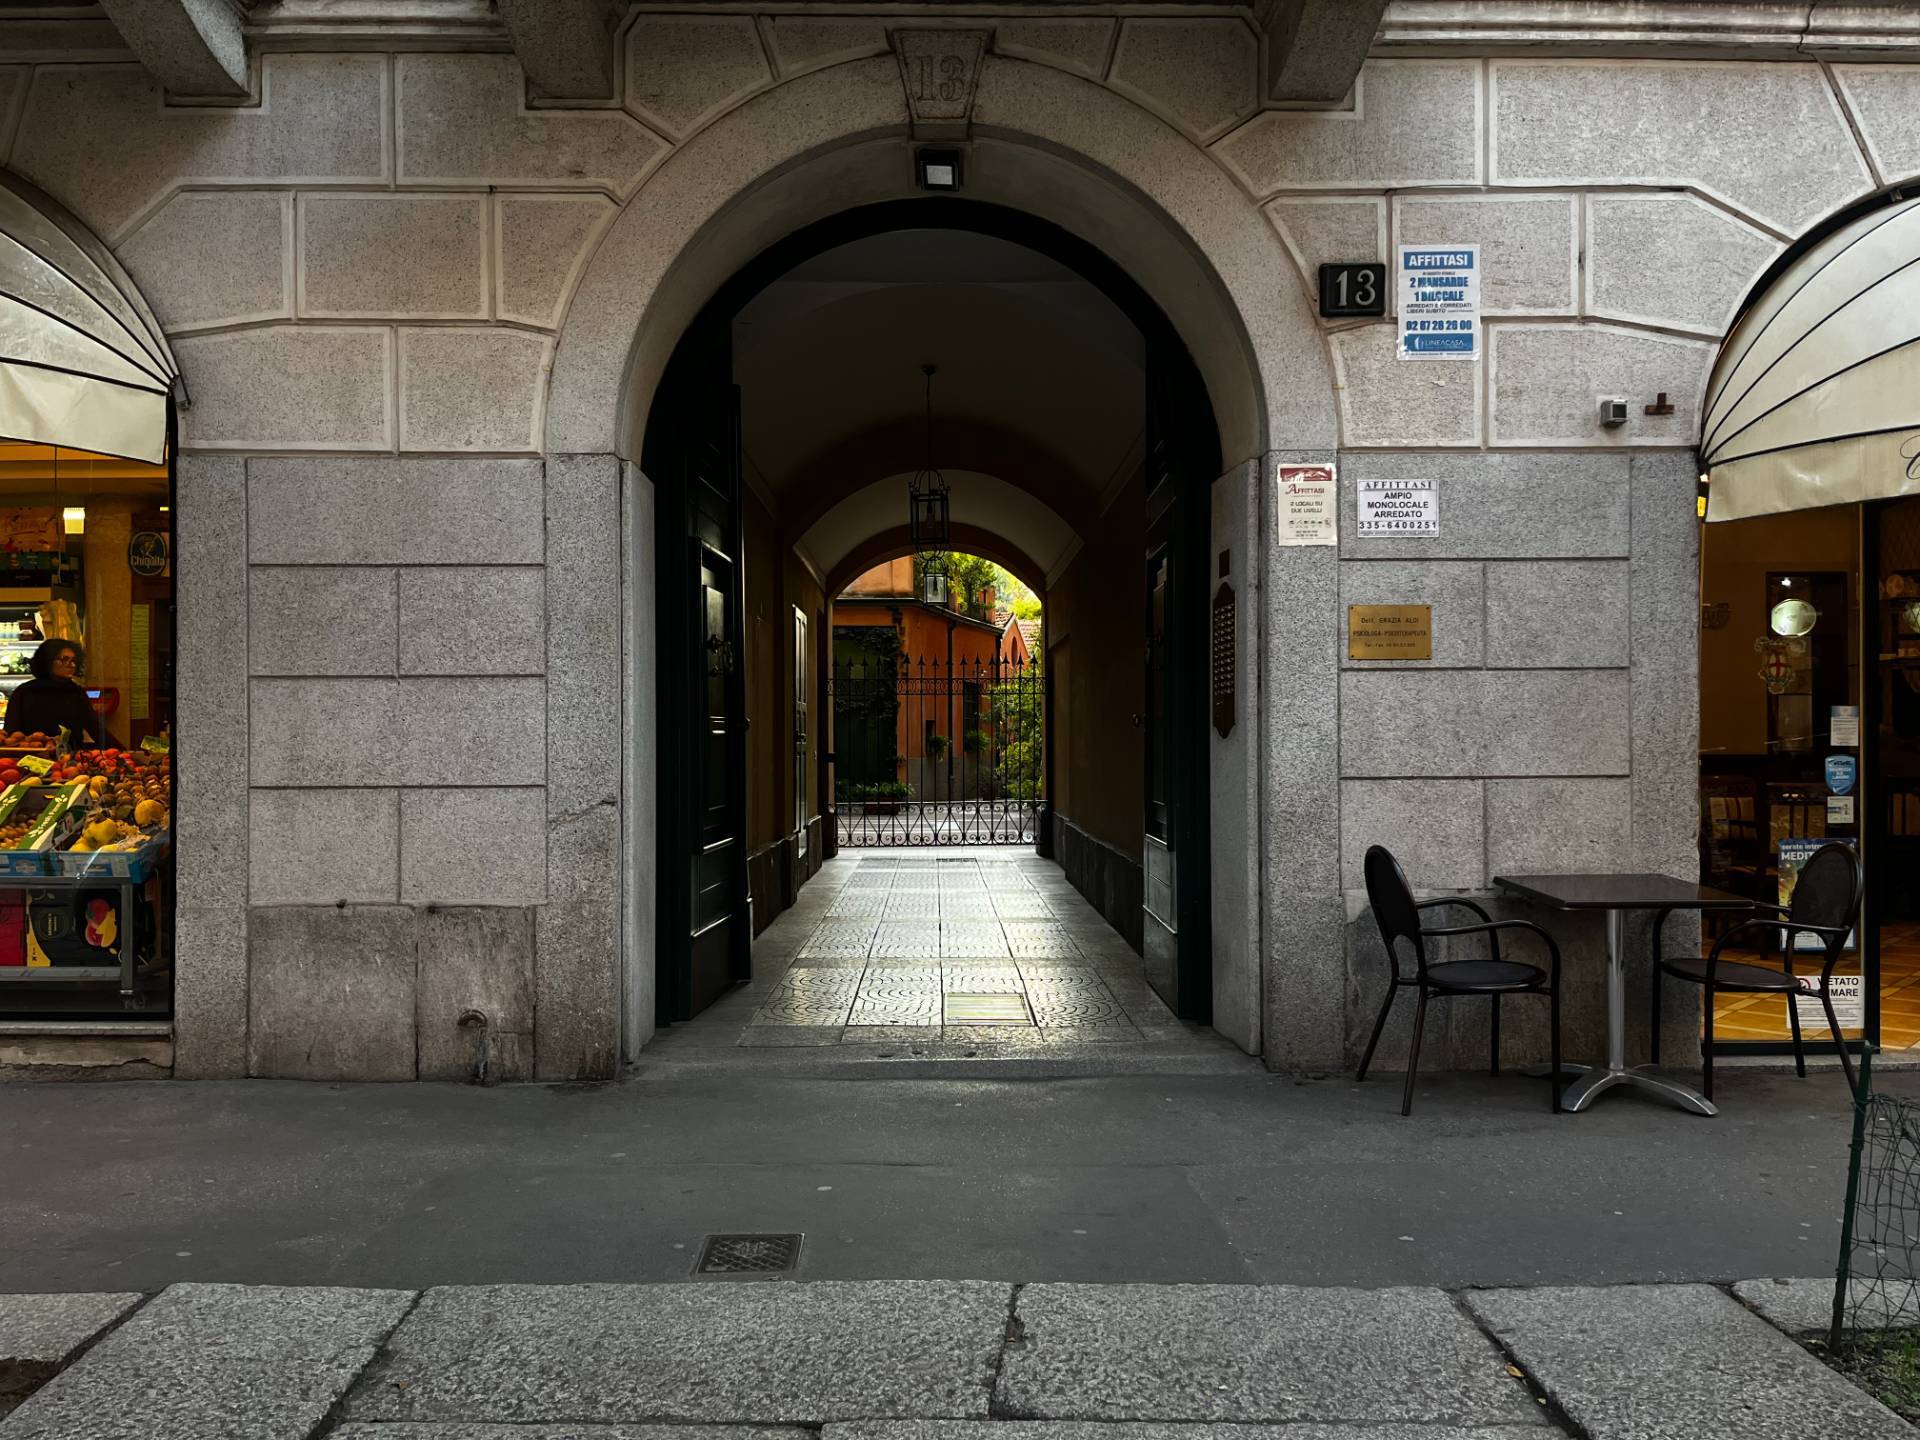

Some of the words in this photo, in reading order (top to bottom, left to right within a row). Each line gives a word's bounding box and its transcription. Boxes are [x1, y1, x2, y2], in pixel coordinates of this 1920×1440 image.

[916, 55, 966, 102] 13
[1408, 254, 1469, 267] AFFITTASI
[1409, 277, 1417, 288] 2
[1417, 276, 1469, 288] MANSARDE
[1335, 269, 1377, 307] 13
[1413, 291, 1420, 302] 1
[1406, 320, 1419, 331] 02
[1284, 483, 1325, 495] AFFITTASI
[1364, 481, 1432, 489] AFFITTASI
[1384, 491, 1413, 500] AMPIO
[1367, 501, 1429, 509] MONOLOCALE
[1374, 510, 1423, 518] ARREDATO
[1781, 851, 1816, 861] MEDIT
[1817, 977, 1859, 986] ETATO
[1830, 988, 1859, 997] MARE
